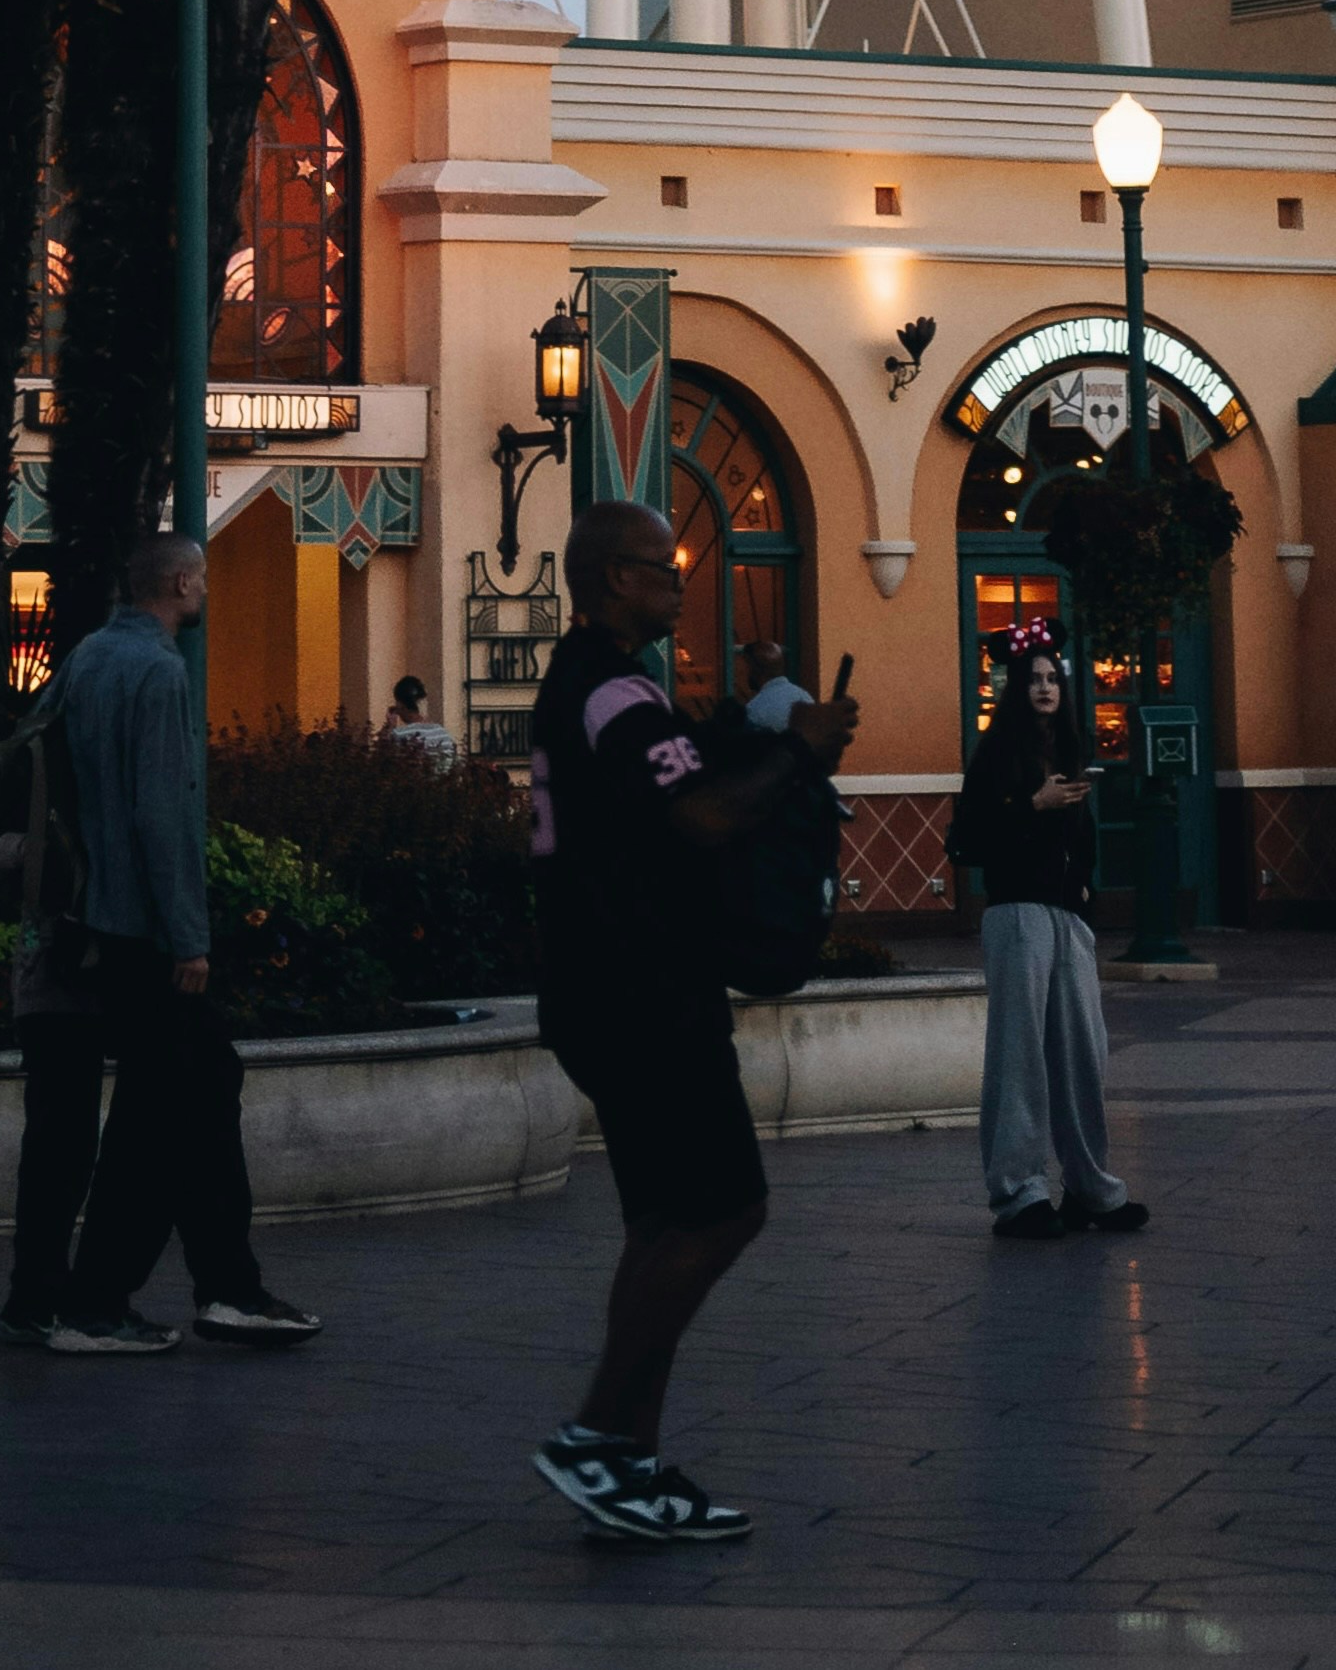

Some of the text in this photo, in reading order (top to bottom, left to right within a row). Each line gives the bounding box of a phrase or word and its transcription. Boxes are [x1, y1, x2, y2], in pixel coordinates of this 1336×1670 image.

[982, 317, 1223, 406] WALT DISNEY STUOS STORE
[237, 393, 320, 429] STUDIOS
[489, 639, 539, 681] GIFTS
